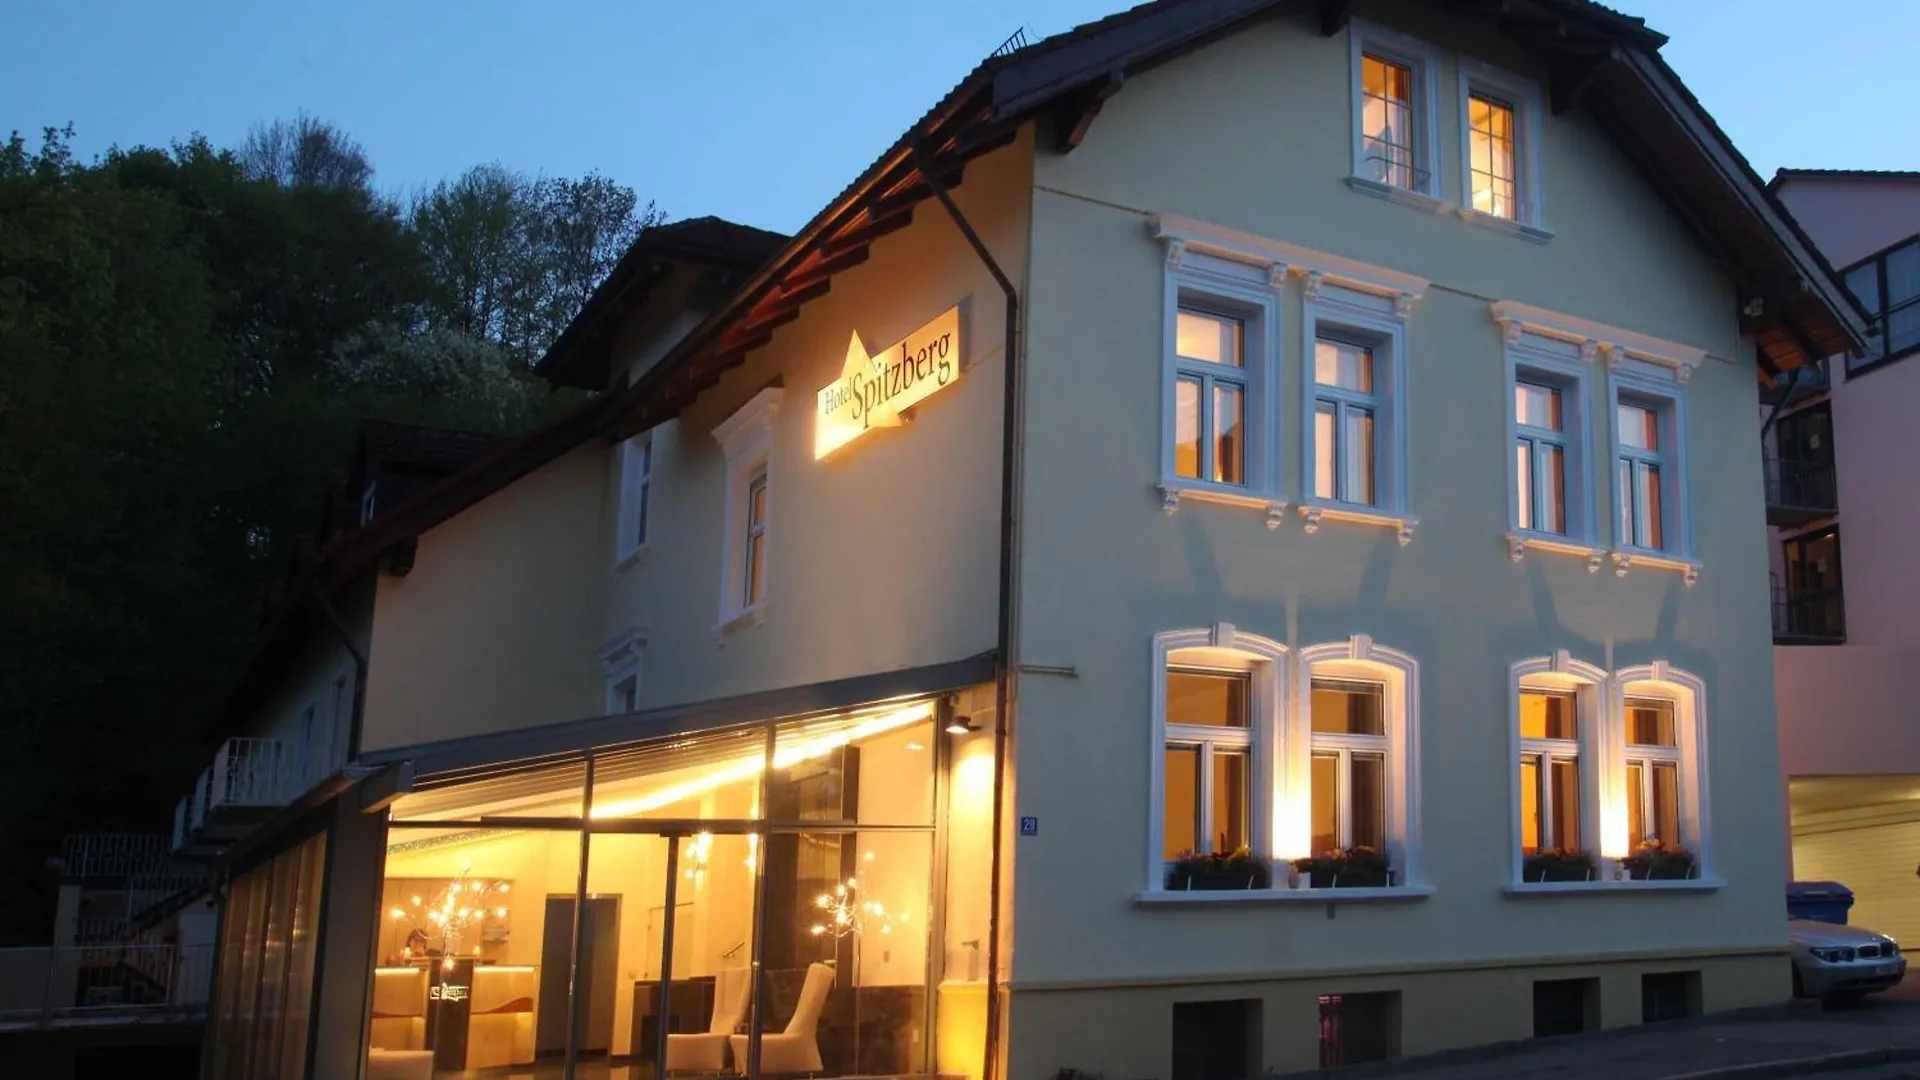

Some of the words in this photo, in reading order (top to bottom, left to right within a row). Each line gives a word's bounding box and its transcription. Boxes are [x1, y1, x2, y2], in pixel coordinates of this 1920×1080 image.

[824, 377, 852, 415] Hotel
[851, 332, 951, 430] Spitzberg
[1023, 818, 1035, 832] 29
